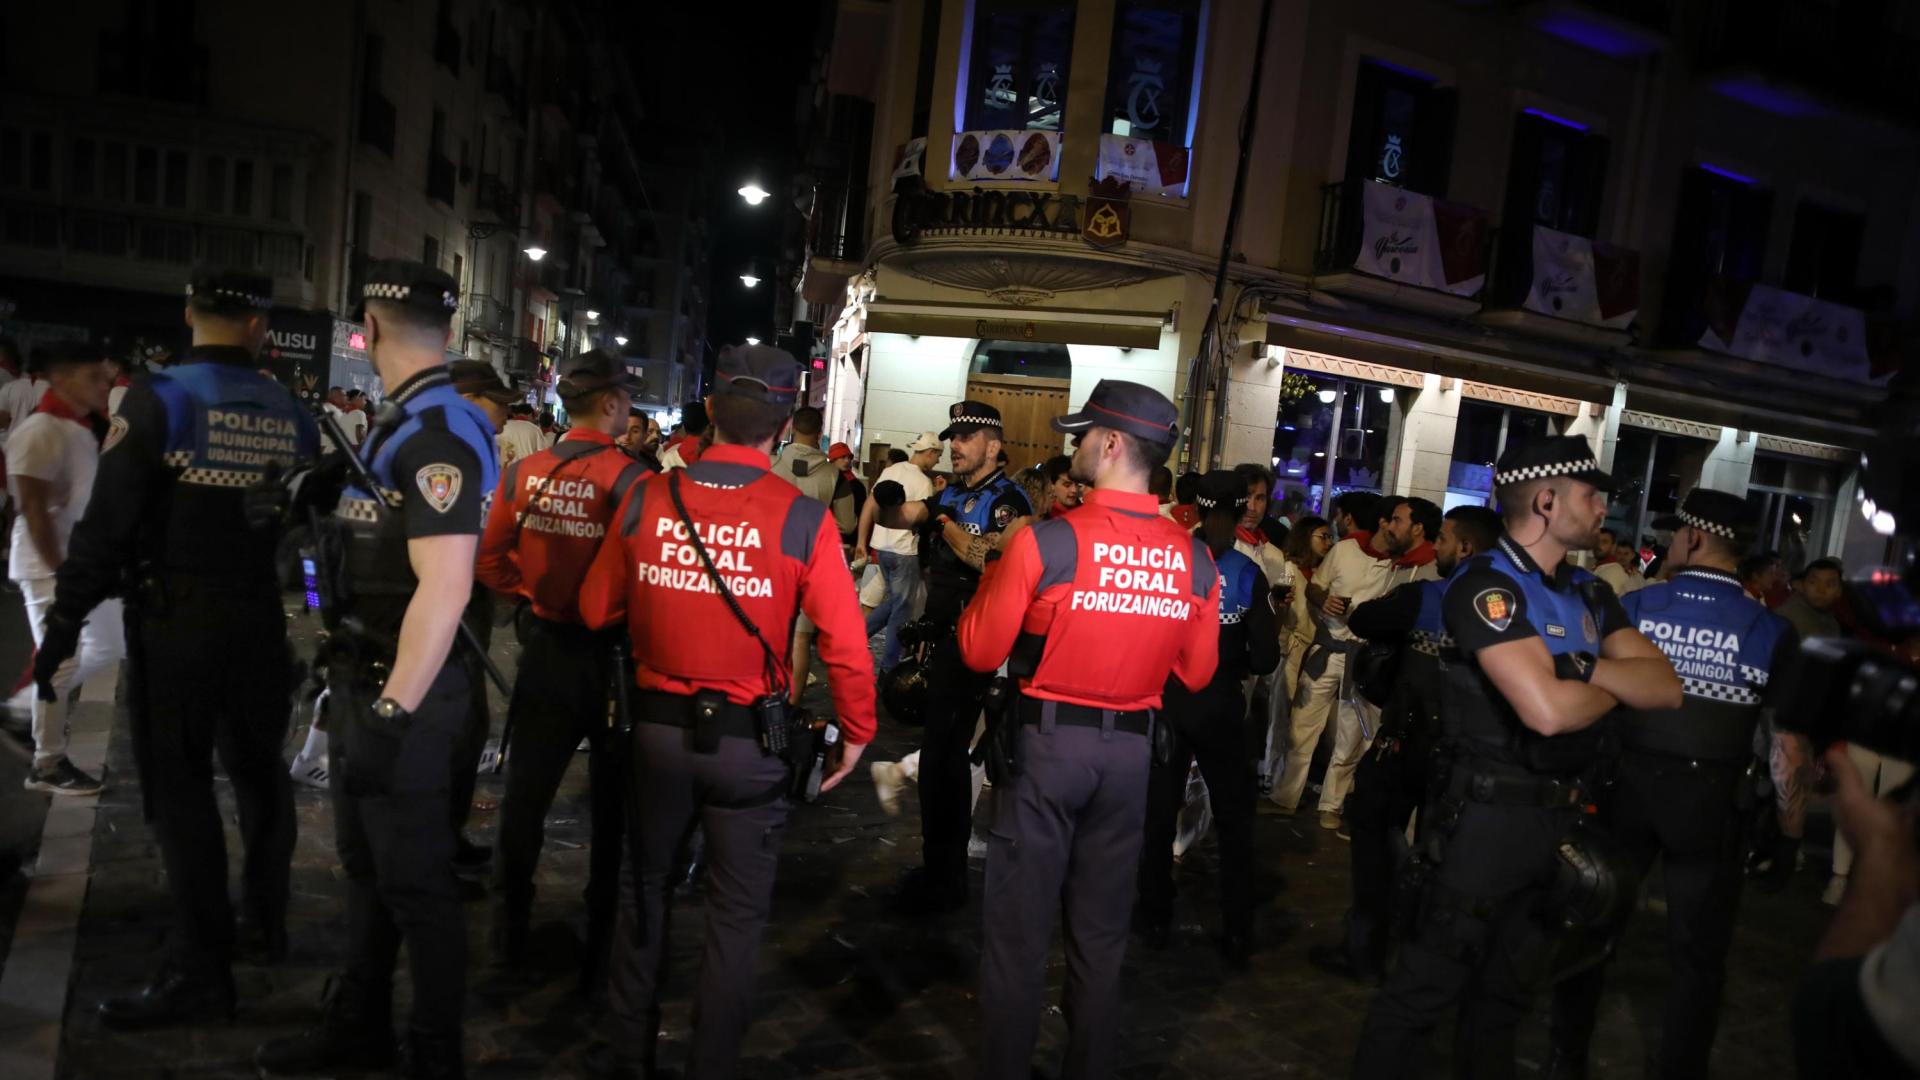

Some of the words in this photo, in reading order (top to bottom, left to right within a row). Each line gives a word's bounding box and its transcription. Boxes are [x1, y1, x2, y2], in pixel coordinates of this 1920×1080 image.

[208, 409, 298, 437] POLICIA
[208, 430, 297, 453] MUNICIPAL
[525, 475, 595, 500] POLICÍA
[655, 516, 762, 549] POLICÍA
[1093, 542, 1187, 572] POLICÍA
[1099, 566, 1179, 595] FORAL
[1071, 590, 1191, 622] FORUZAINGOA
[1638, 618, 1740, 652] POLICIA
[1651, 639, 1737, 667] UNICIPAL
